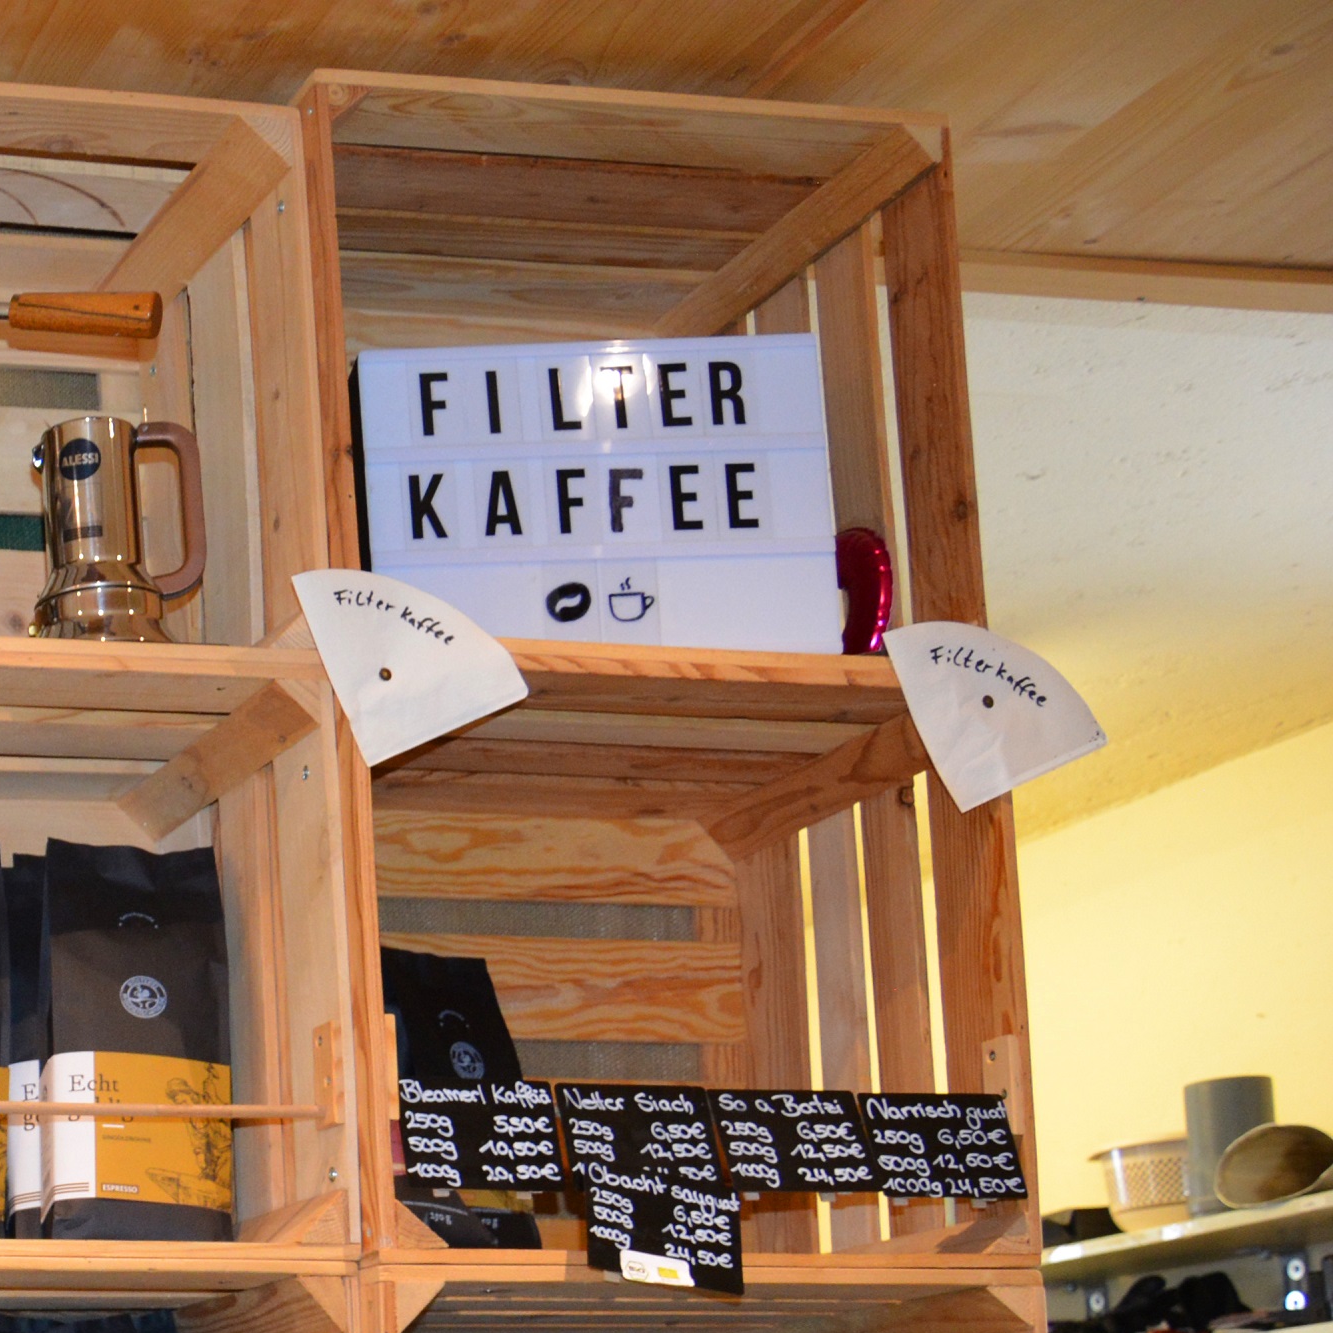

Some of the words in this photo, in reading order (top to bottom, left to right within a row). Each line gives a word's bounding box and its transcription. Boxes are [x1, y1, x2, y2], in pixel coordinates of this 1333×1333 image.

[418, 361, 747, 436] FILTER
[408, 464, 760, 539] KAFFEE
[68, 1074, 119, 1093] Echt
[563, 1088, 625, 1111] Netter
[633, 1089, 694, 1114] Siach
[718, 1094, 747, 1111] So
[966, 1101, 1006, 1130] guat
[588, 1162, 667, 1195] Obacht
